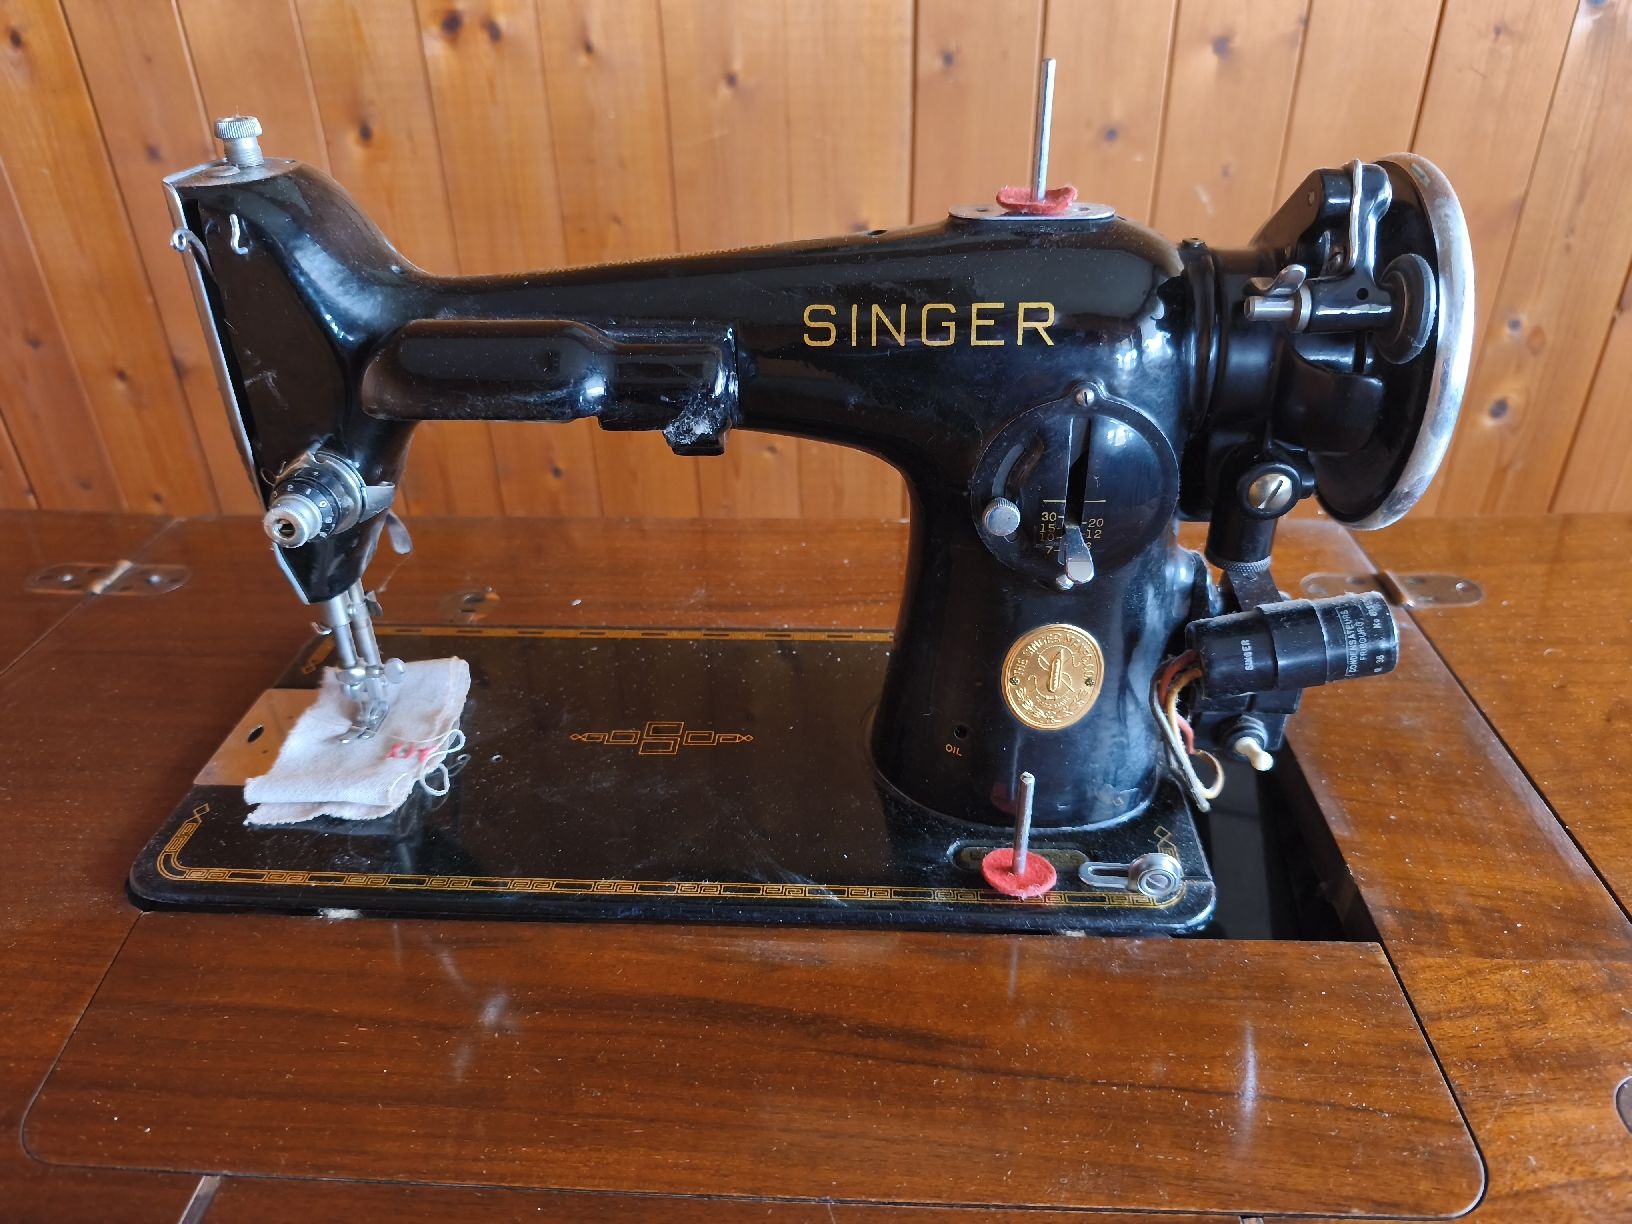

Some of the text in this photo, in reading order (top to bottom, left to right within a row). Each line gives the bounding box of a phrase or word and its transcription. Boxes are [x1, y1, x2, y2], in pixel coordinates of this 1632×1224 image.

[803, 302, 1056, 347] SINGER
[1041, 511, 1057, 521] 30
[1039, 523, 1056, 533] 15
[1088, 518, 1104, 528] 20
[1039, 532, 1055, 542] 10
[1086, 529, 1102, 539] 12
[1045, 545, 1054, 554] 7
[1240, 639, 1254, 671] SINGER
[1013, 657, 1028, 675] THE
[945, 743, 963, 757] OIL
